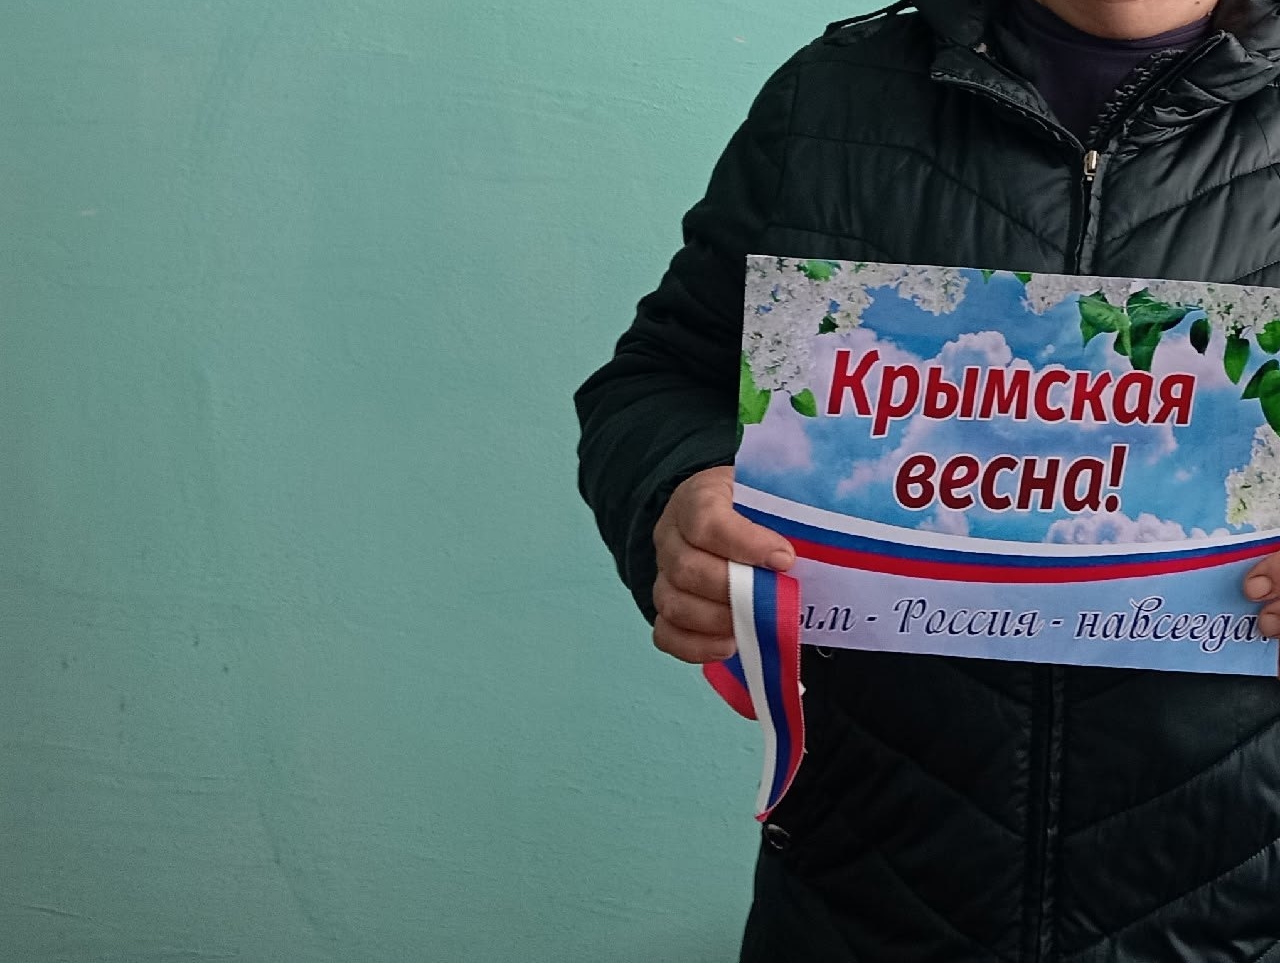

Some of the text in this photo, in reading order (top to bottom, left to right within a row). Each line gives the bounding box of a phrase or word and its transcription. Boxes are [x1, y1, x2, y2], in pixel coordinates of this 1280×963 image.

[826, 348, 1196, 437] Крымская
[893, 444, 1127, 513] весна!
[799, 605, 856, 632] ым
[893, 598, 1046, 638] Россия
[1076, 597, 1267, 652] навсегда
